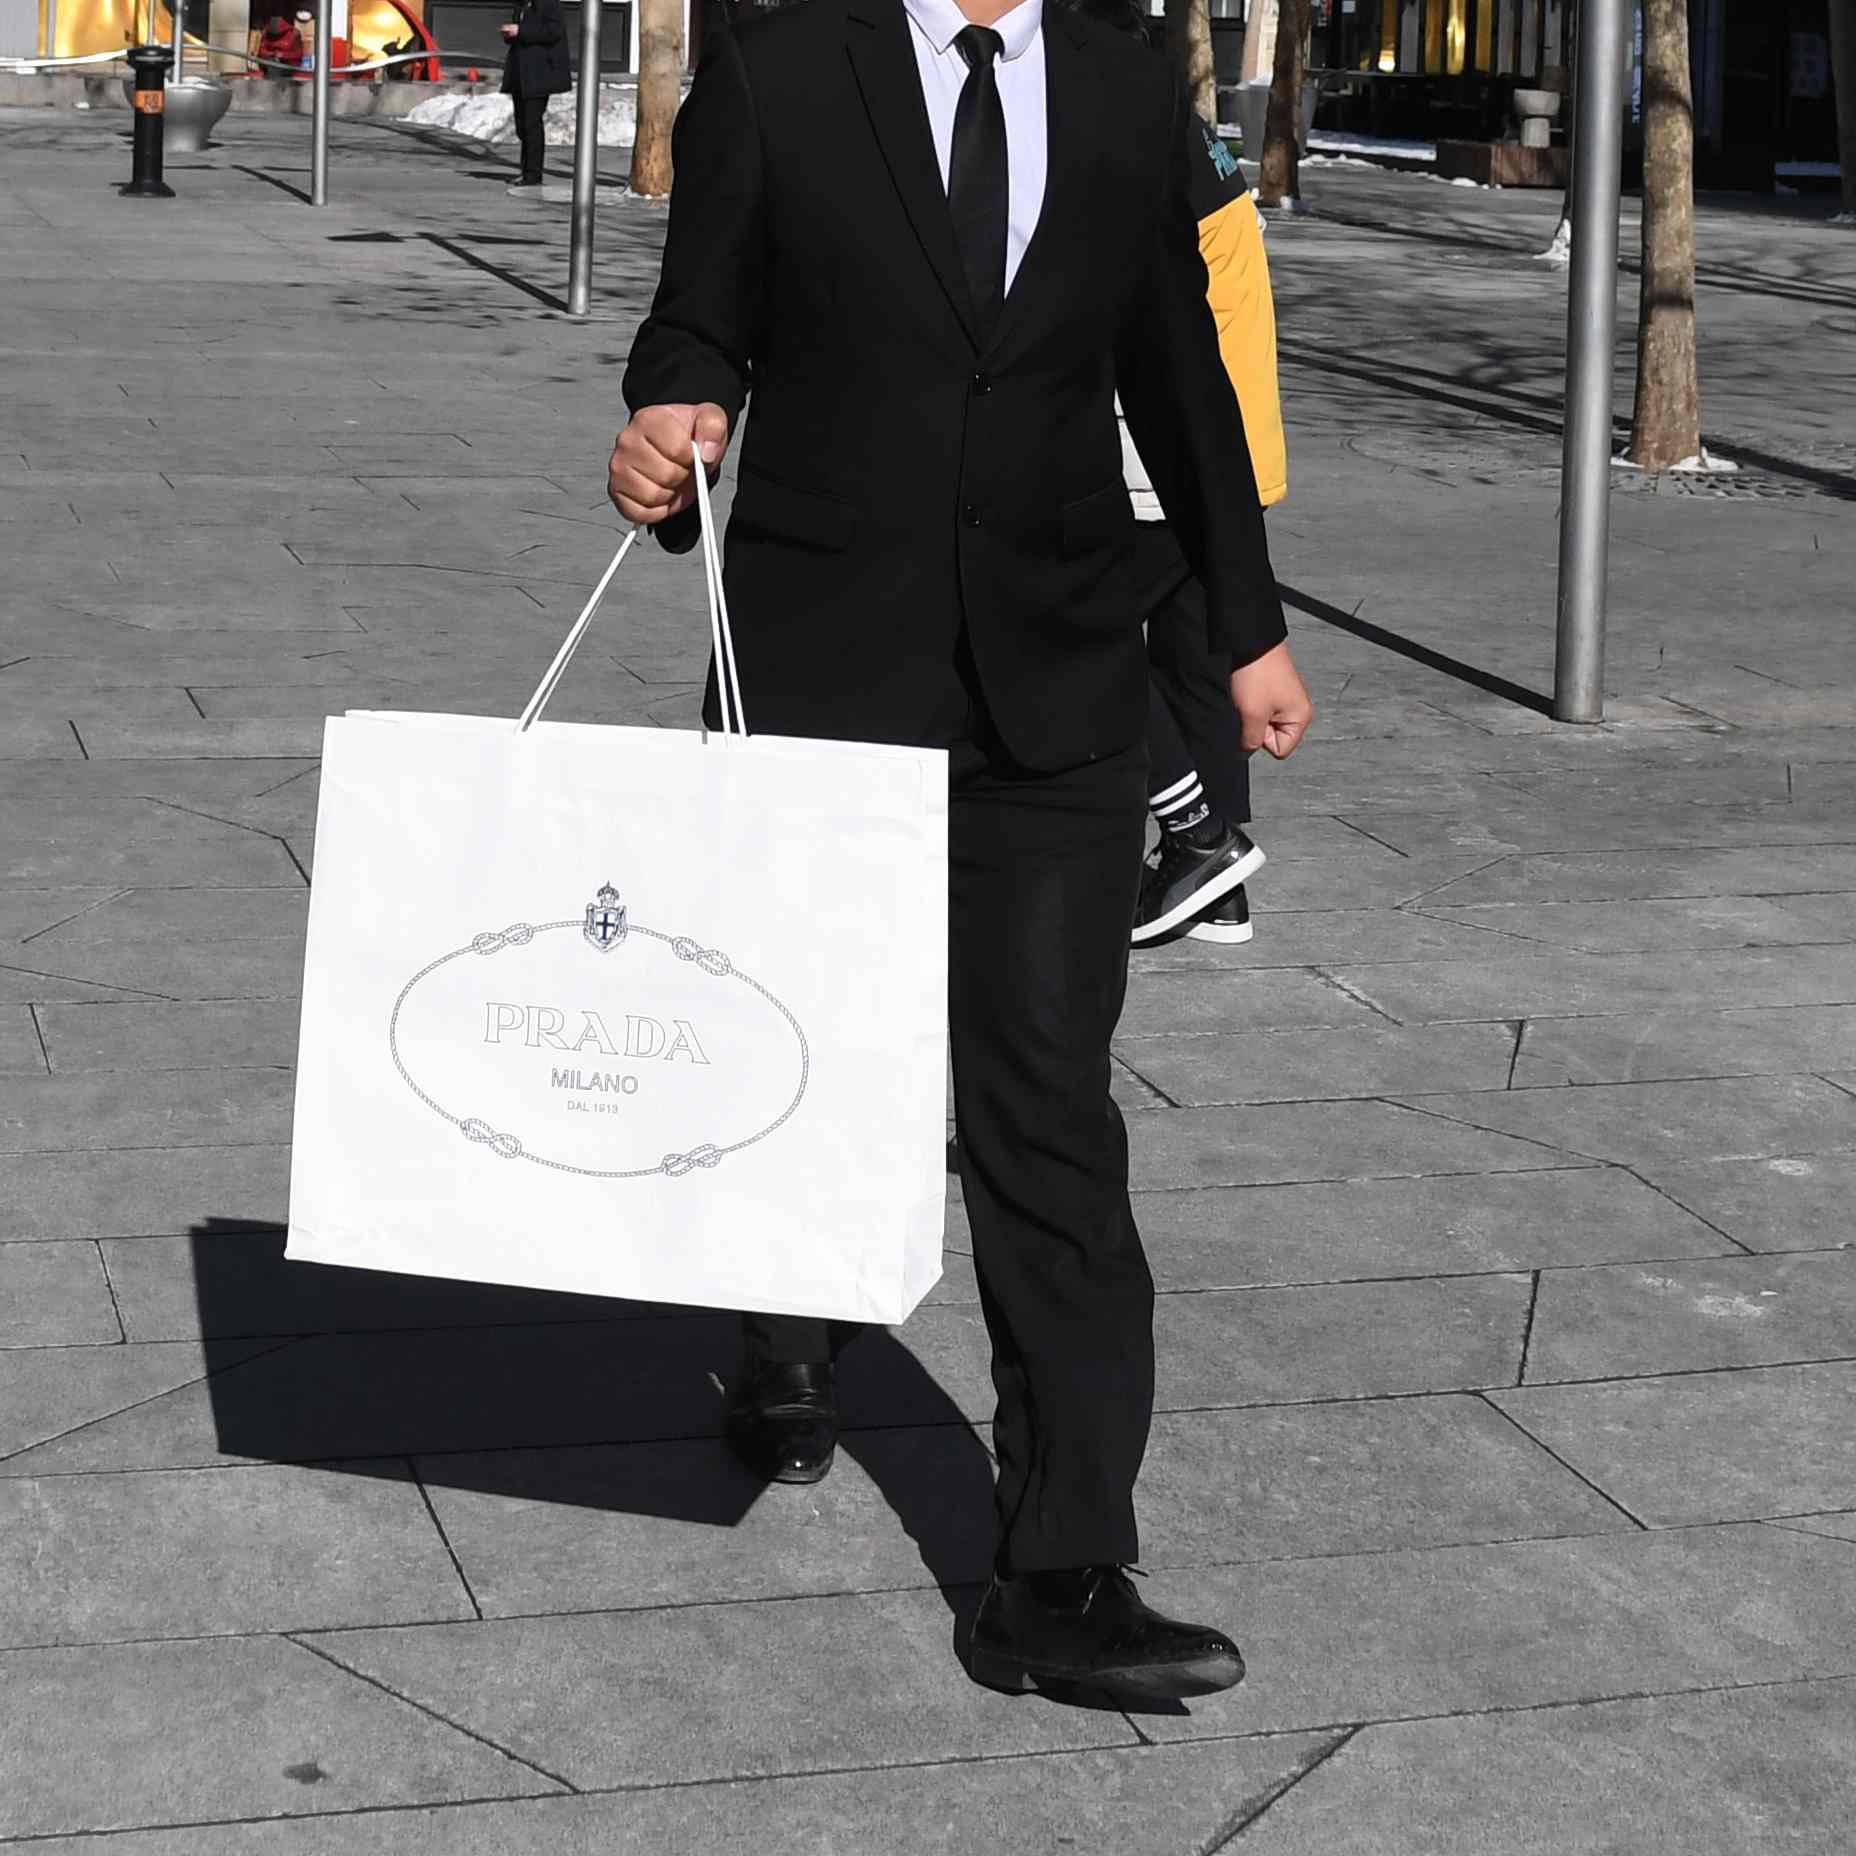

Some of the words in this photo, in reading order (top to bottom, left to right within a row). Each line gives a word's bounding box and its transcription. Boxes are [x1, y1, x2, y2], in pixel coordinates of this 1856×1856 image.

[484, 1002, 711, 1064] PRADA
[551, 1067, 639, 1095] MILANO
[567, 1100, 590, 1112] DAL
